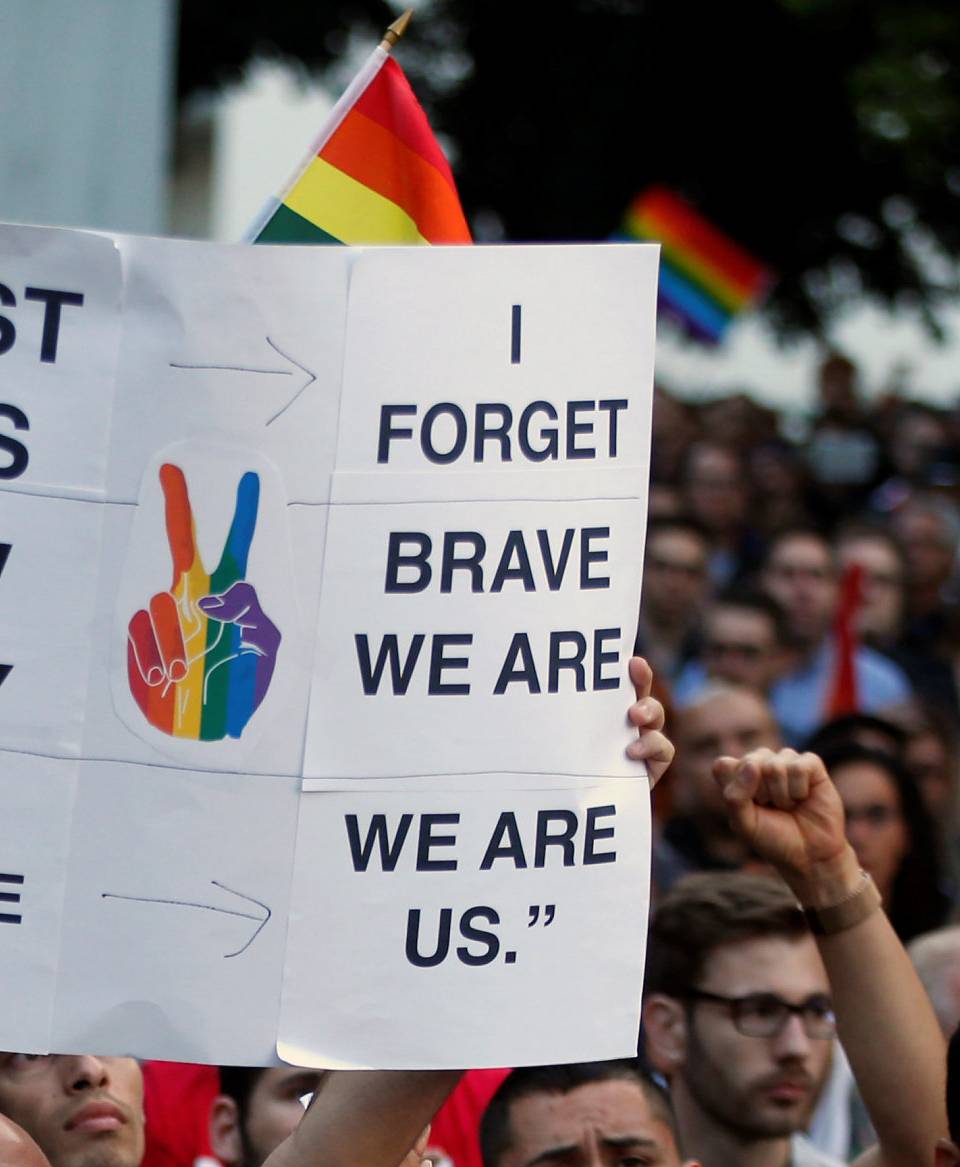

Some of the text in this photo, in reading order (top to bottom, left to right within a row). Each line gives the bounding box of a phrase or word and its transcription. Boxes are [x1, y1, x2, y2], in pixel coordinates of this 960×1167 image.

[510, 304, 522, 365] I
[376, 399, 629, 466] FORGET
[384, 526, 611, 595] BRAVE
[353, 626, 622, 697] WE ARE
[343, 805, 617, 873] WE ARE
[405, 903, 556, 968] US.”
